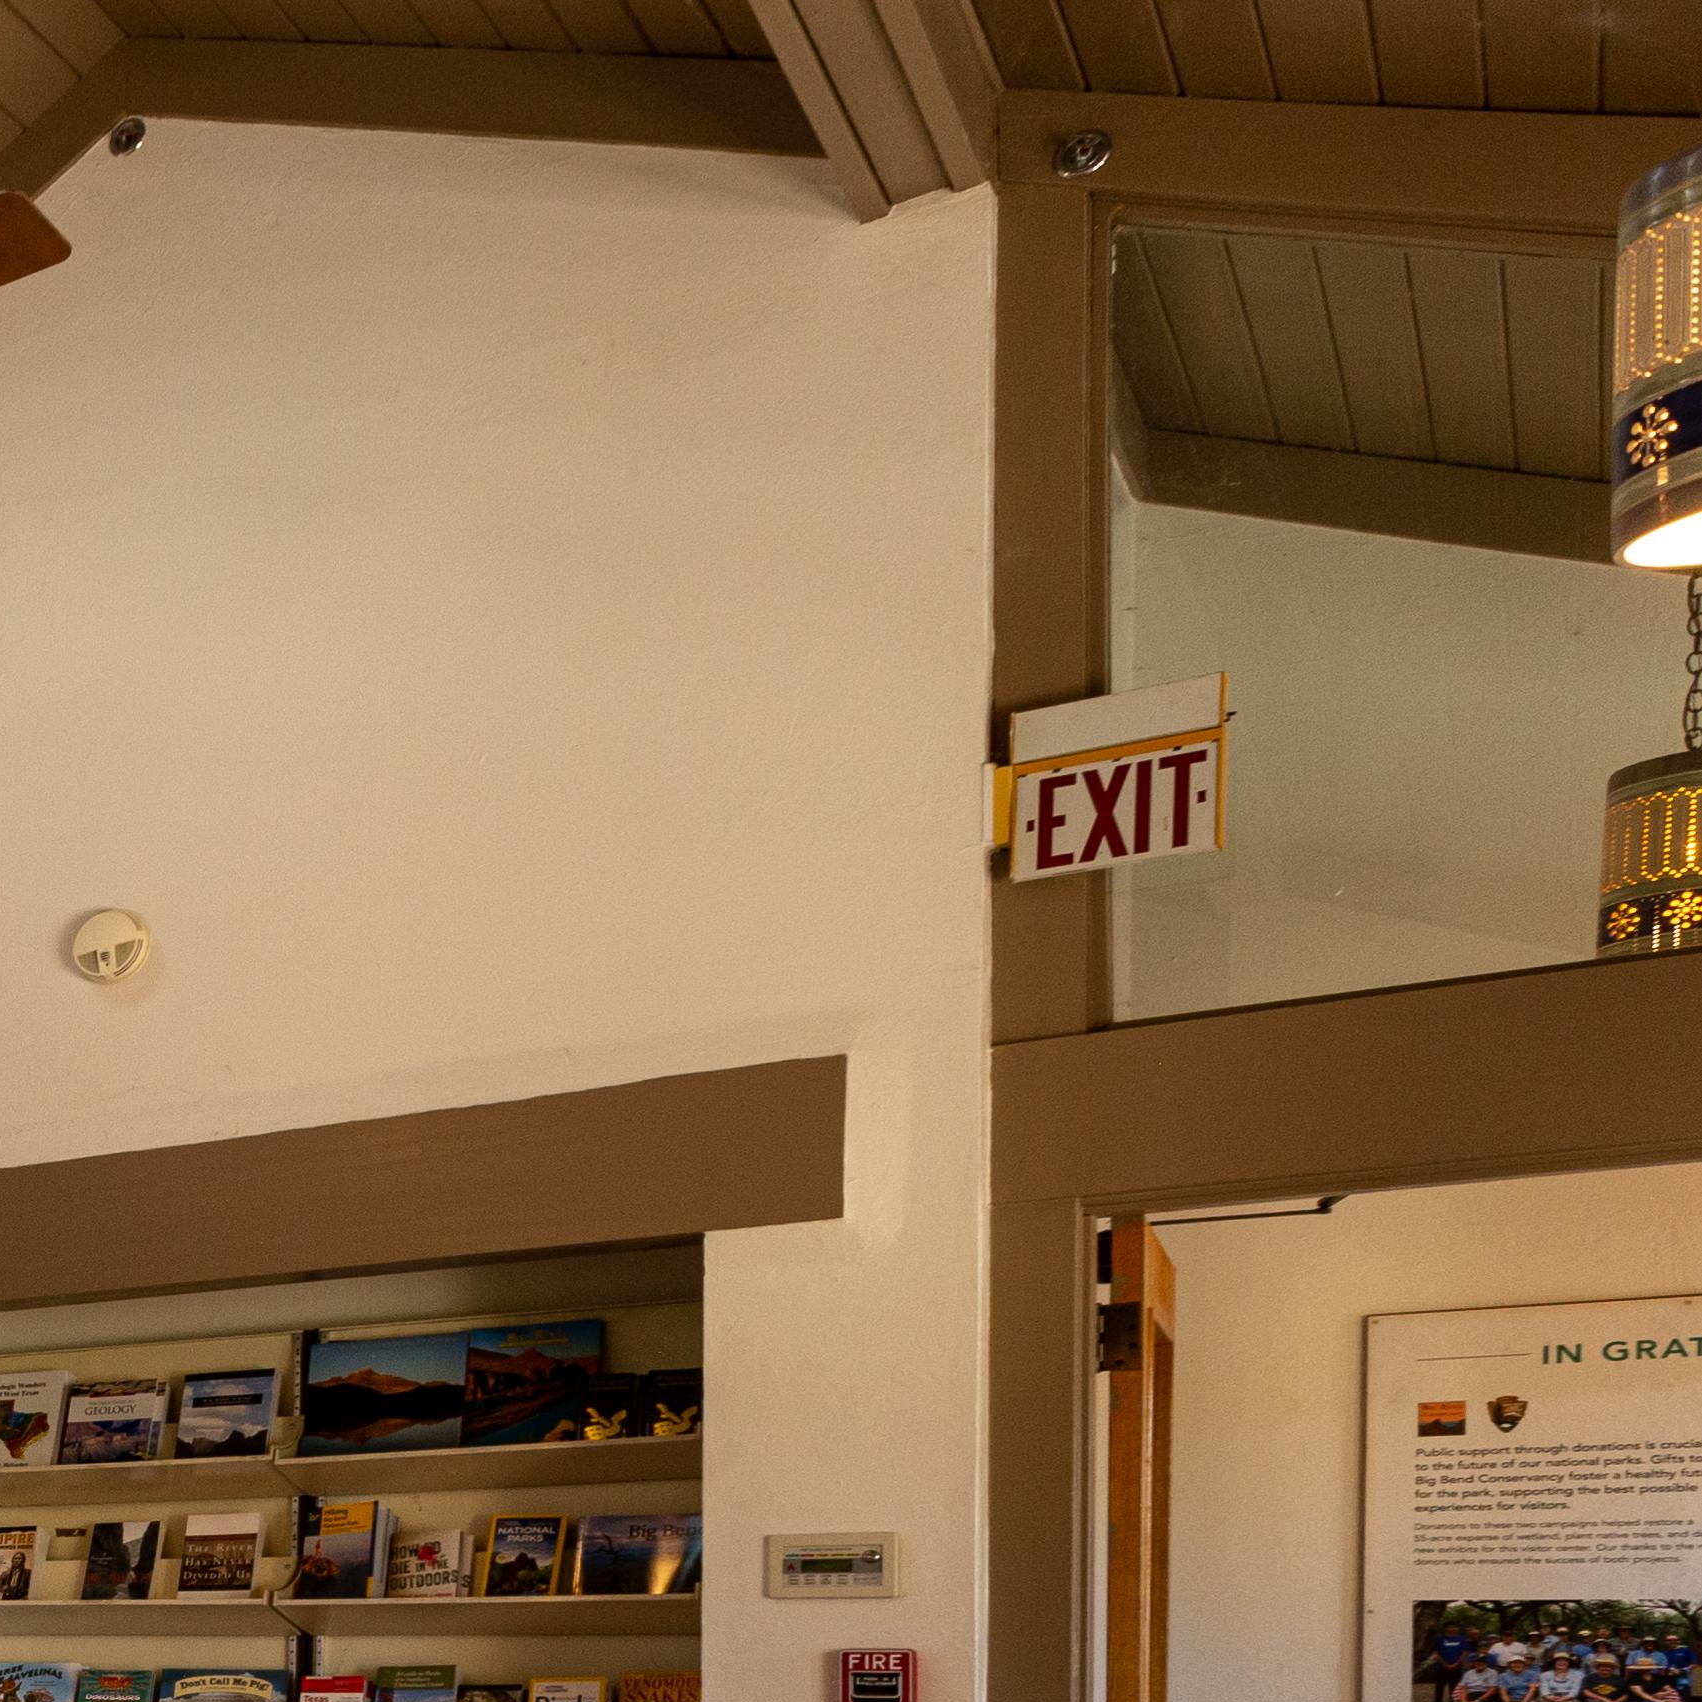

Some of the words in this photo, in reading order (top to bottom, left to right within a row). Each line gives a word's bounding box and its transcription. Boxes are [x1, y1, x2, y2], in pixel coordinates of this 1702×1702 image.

[1036, 749, 1208, 870] EXIT
[1542, 1344, 1582, 1365] IN
[84, 1404, 137, 1416] GEOLOGY
[1416, 1447, 1454, 1457] Public
[1458, 1447, 1511, 1457] support
[1514, 1444, 1567, 1456] through
[1572, 1442, 1641, 1452] donations
[1645, 1441, 1655, 1449] is
[1415, 1463, 1429, 1471] to
[1432, 1461, 1453, 1470] the
[1457, 1460, 1497, 1470] future
[1501, 1458, 1515, 1468] of
[1518, 1460, 1541, 1468] our
[1545, 1457, 1599, 1467] national
[1650, 1454, 1685, 1464] Gifts
[1415, 1475, 1436, 1487] Big
[1440, 1474, 1474, 1484] Bend
[1478, 1473, 1564, 1484] Conservancy
[1568, 1470, 1609, 1480] foster
[1625, 1469, 1676, 1480] healthy
[1414, 1489, 1433, 1499] for
[1437, 1489, 1458, 1498] the
[1499, 1486, 1574, 1498] supporting
[1577, 1485, 1600, 1494] the
[1604, 1485, 1635, 1494] best
[1639, 1483, 1699, 1495] possible
[1414, 1503, 1493, 1513] experiences
[1496, 1501, 1515, 1511] for
[498, 1526, 556, 1535] NATIONAL
[507, 1534, 544, 1543] PARKS
[629, 1525, 657, 1541] Big
[390, 1570, 460, 1591] OUTDOORS
[849, 1654, 903, 1670] FIRE
[303, 1695, 329, 1702] Texas
[627, 1689, 698, 1702] SNAKES
